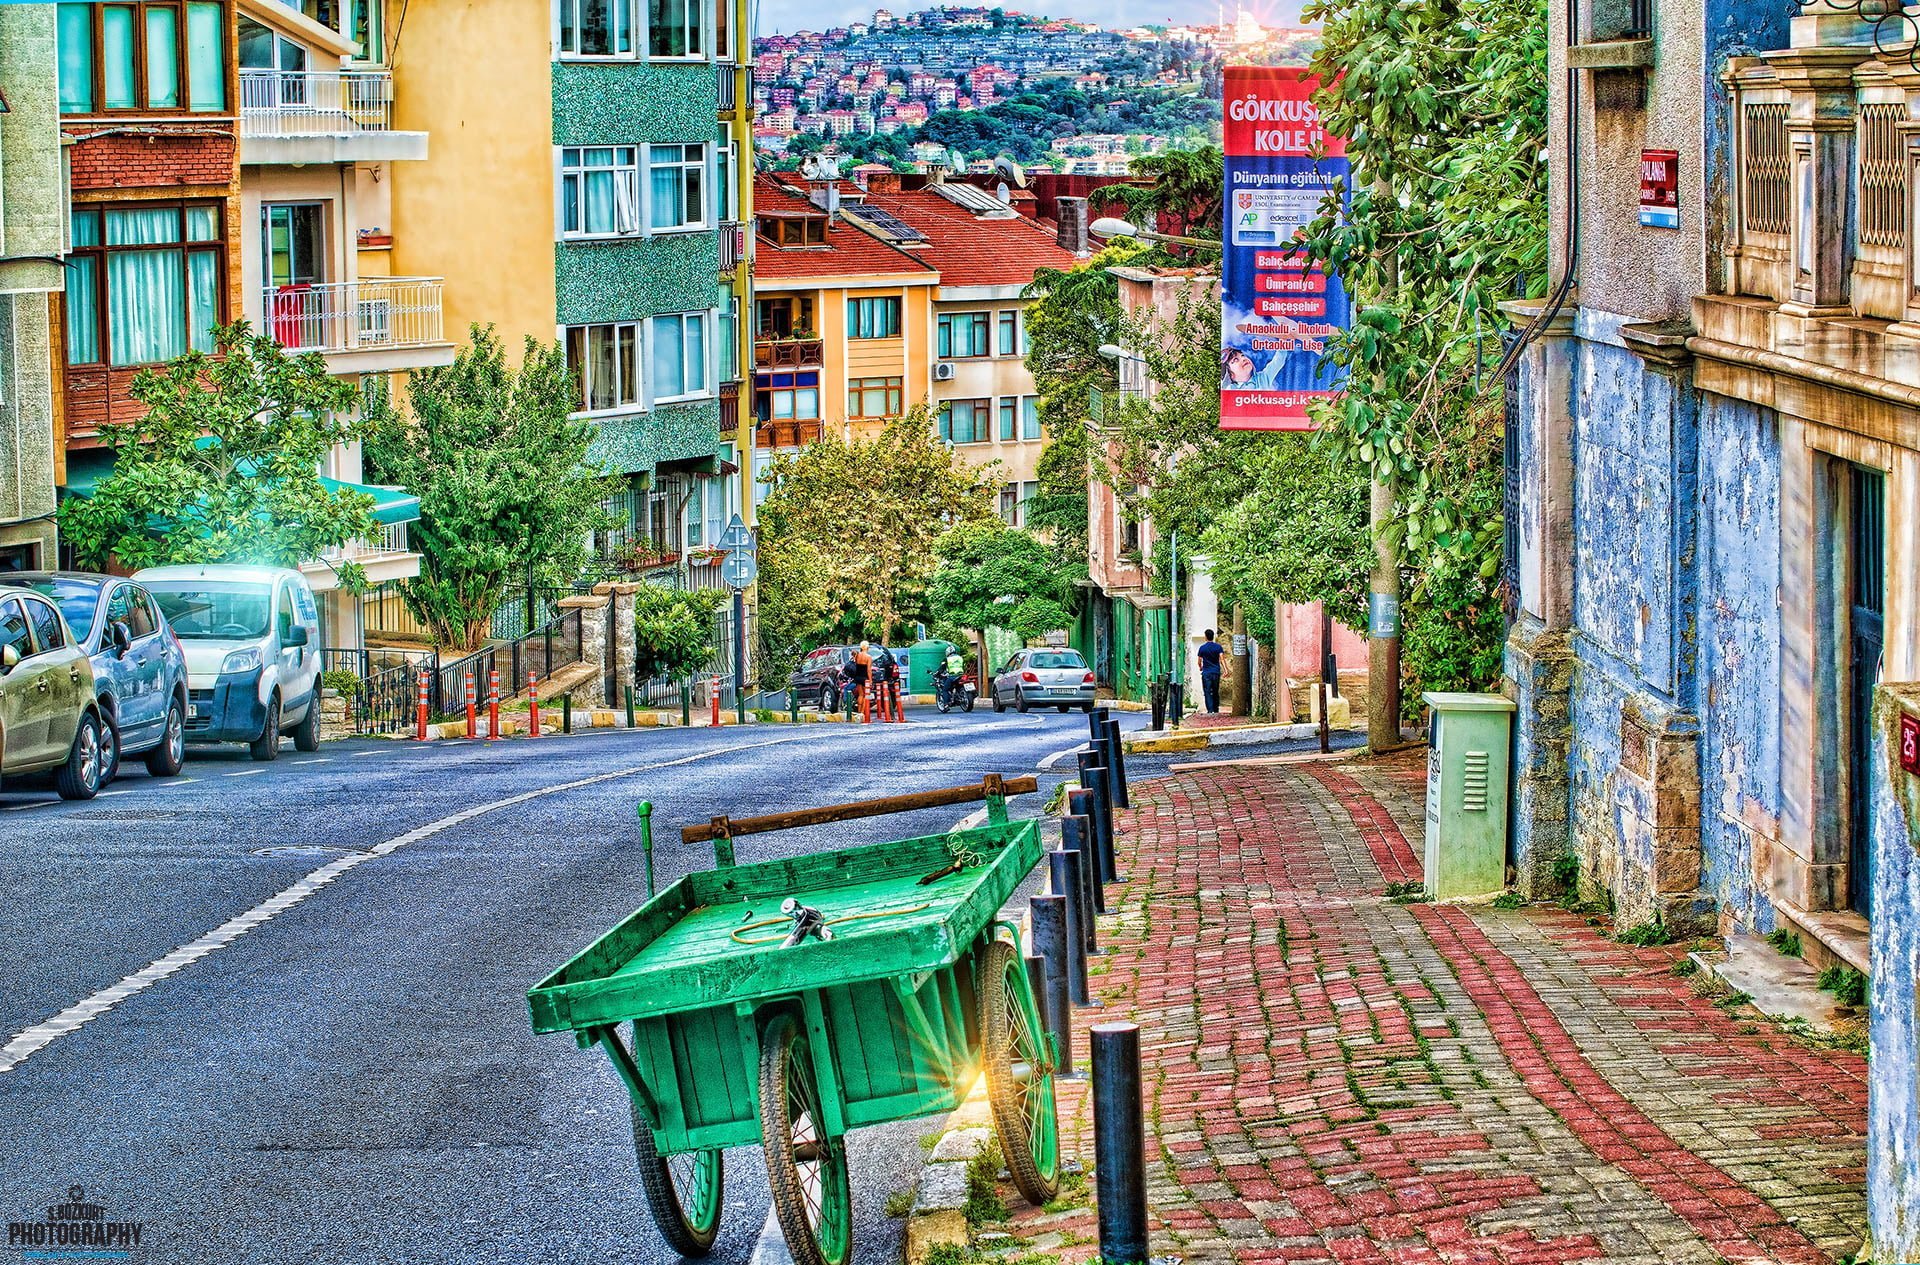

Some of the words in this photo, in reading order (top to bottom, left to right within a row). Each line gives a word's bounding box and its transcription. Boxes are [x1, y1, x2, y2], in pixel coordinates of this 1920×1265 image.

[1229, 93, 1329, 128] GÖKKUŞ
[1255, 126, 1323, 151] KOLEJİ
[1233, 171, 1288, 187] Dünyanın
[1239, 212, 1258, 226] AP
[1270, 214, 1298, 222] edexcel
[1265, 276, 1315, 291] Ümraniye
[1261, 300, 1320, 314] Bahçeşehir
[1246, 322, 1290, 335] Anaokulu
[1297, 320, 1331, 335] İlkokul
[1252, 338, 1296, 351] Ortaokul
[1302, 339, 1324, 351] Lise
[1234, 393, 1331, 408] gokkusagi.k
